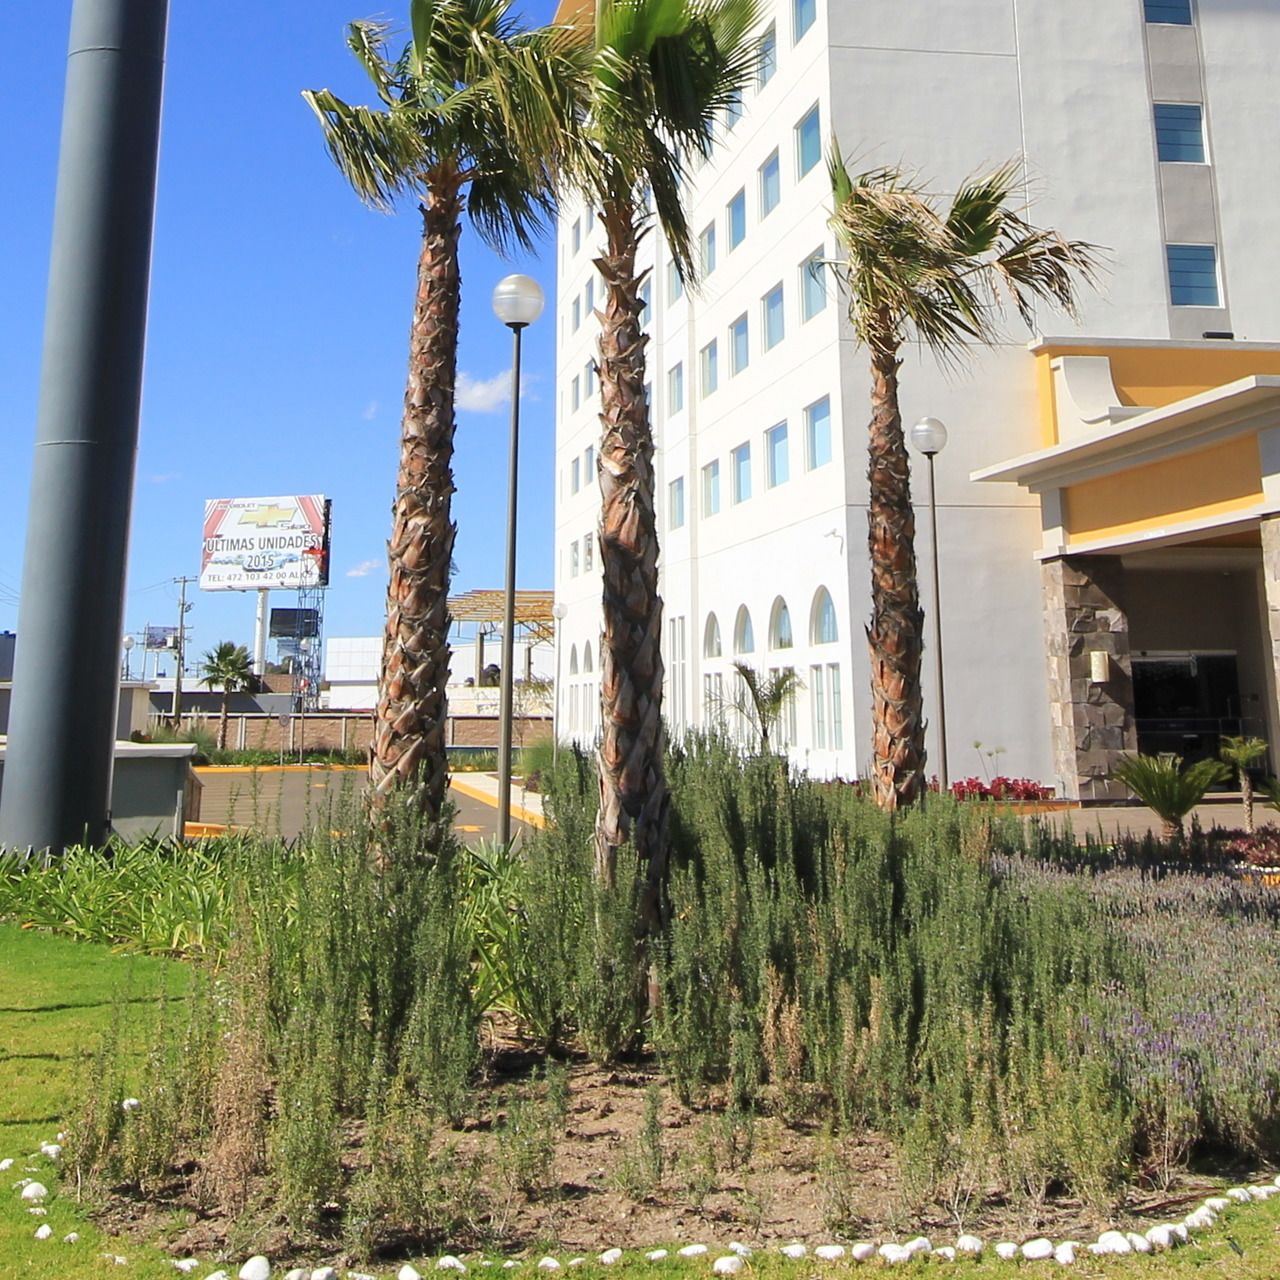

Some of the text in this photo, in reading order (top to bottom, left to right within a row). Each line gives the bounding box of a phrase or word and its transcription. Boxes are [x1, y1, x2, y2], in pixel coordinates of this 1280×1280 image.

[207, 535, 317, 552] ULTIMAS UNIDADES
[247, 555, 274, 568] 2015
[208, 574, 224, 582] TEL:
